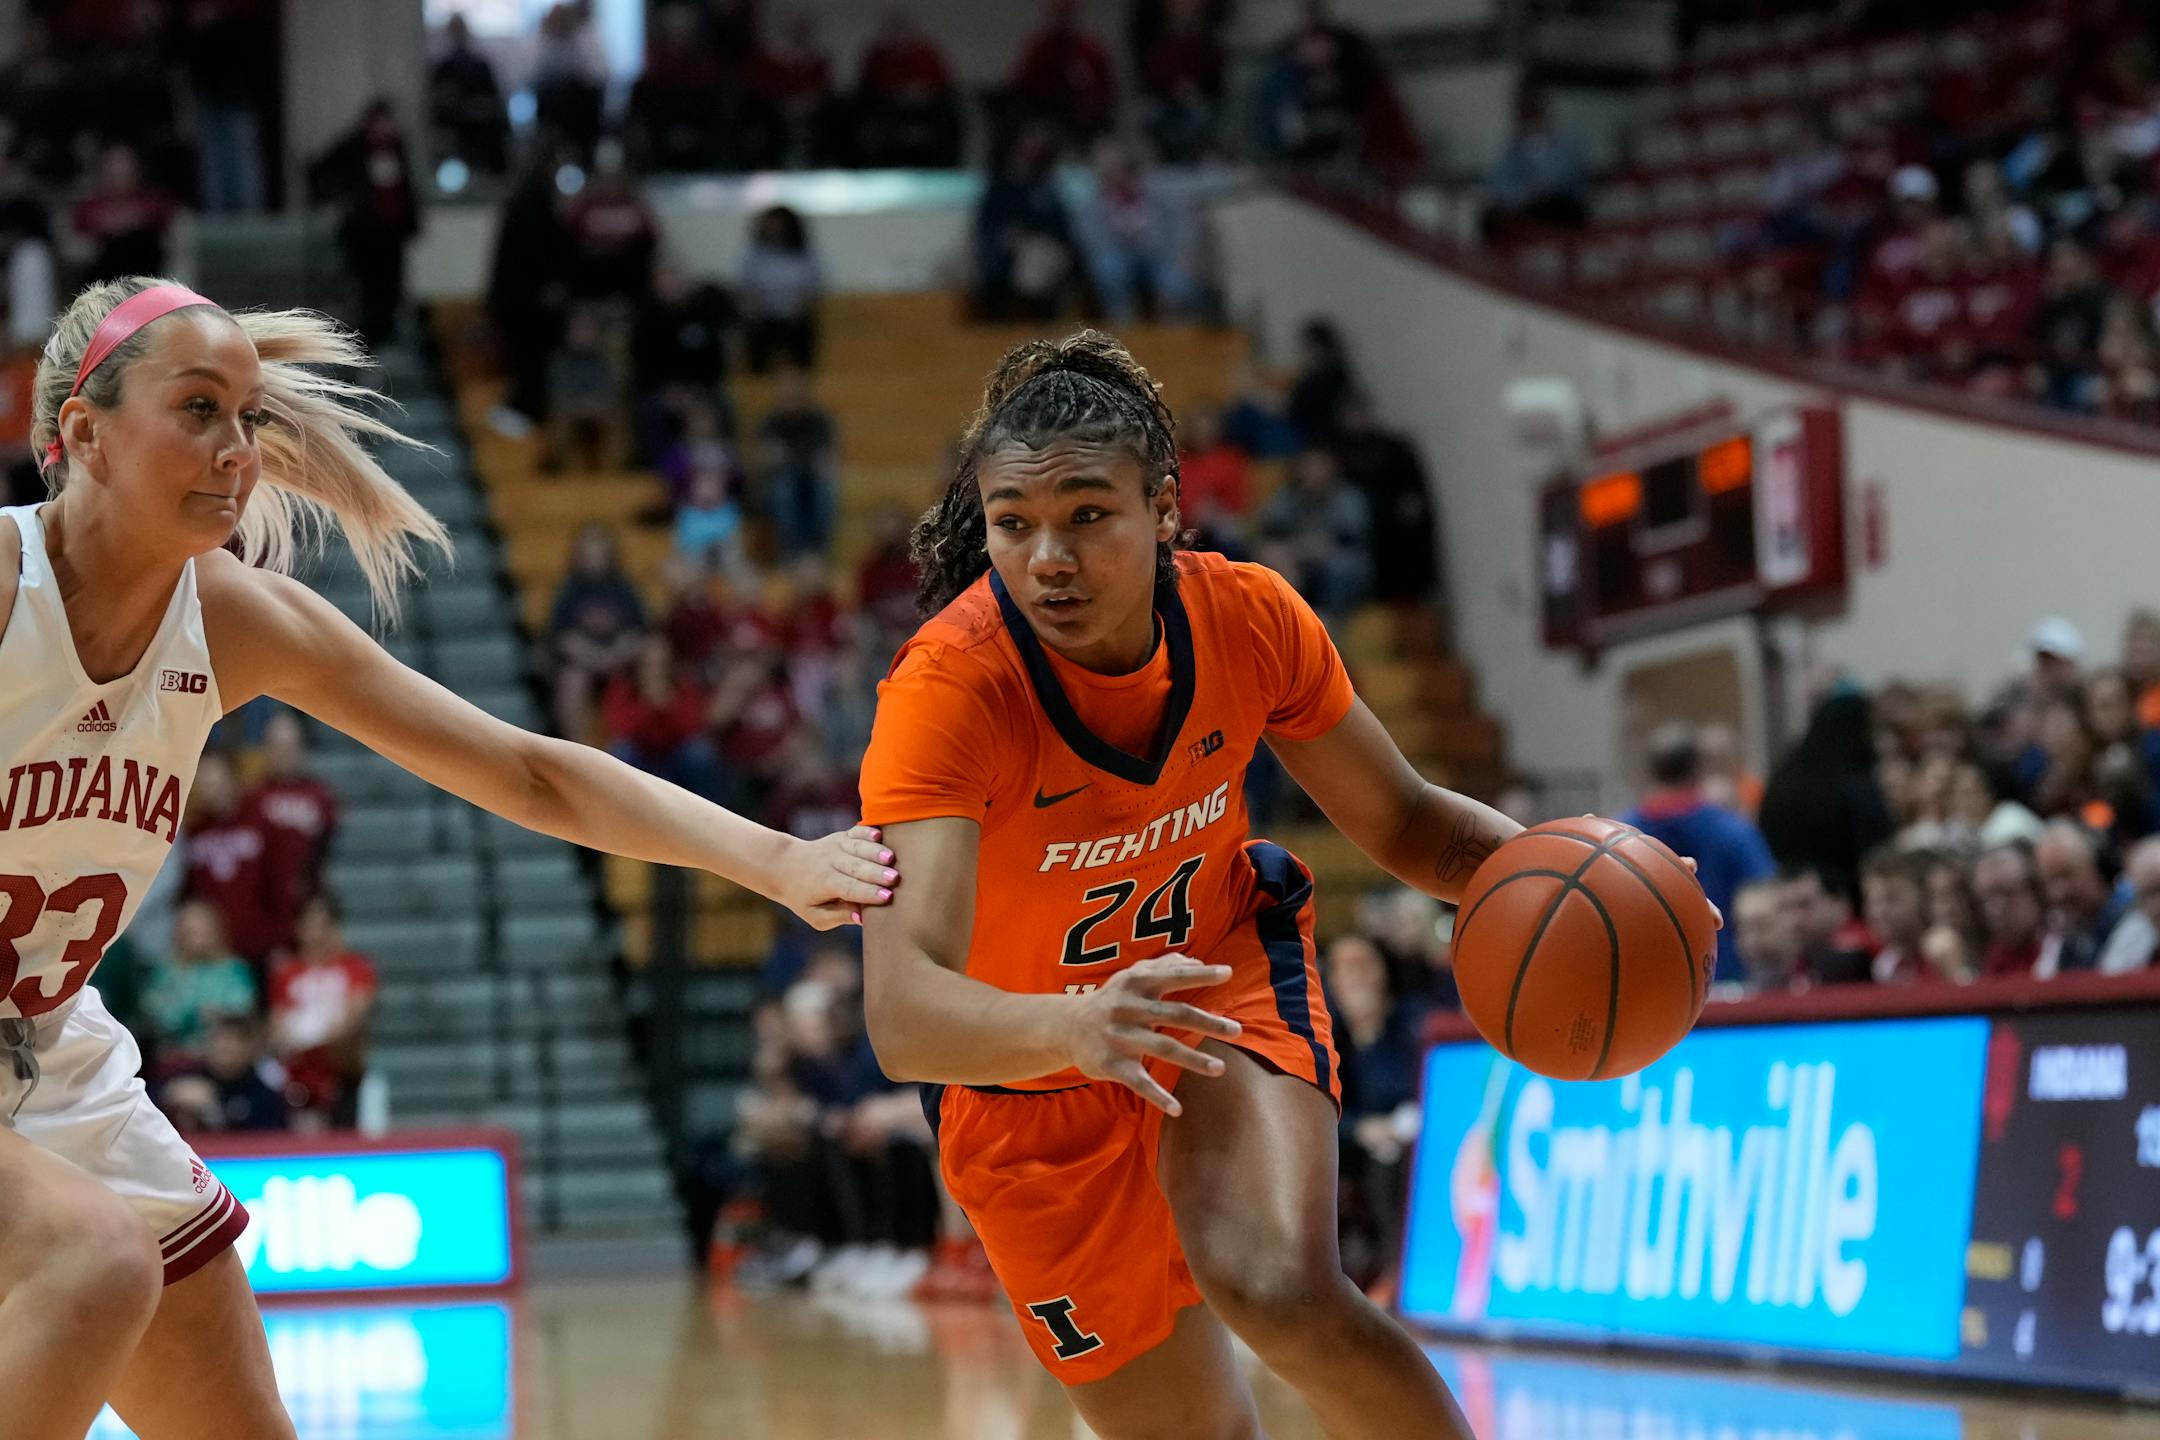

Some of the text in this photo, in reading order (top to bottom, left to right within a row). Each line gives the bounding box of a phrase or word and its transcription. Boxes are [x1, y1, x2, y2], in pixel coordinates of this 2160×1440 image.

[77, 719, 117, 733] adidas
[1038, 780, 1229, 873] FIGHTING
[1059, 852, 1206, 966] 24
[1494, 1060, 1879, 1318] Smithville
[1026, 1295, 1105, 1361] I
